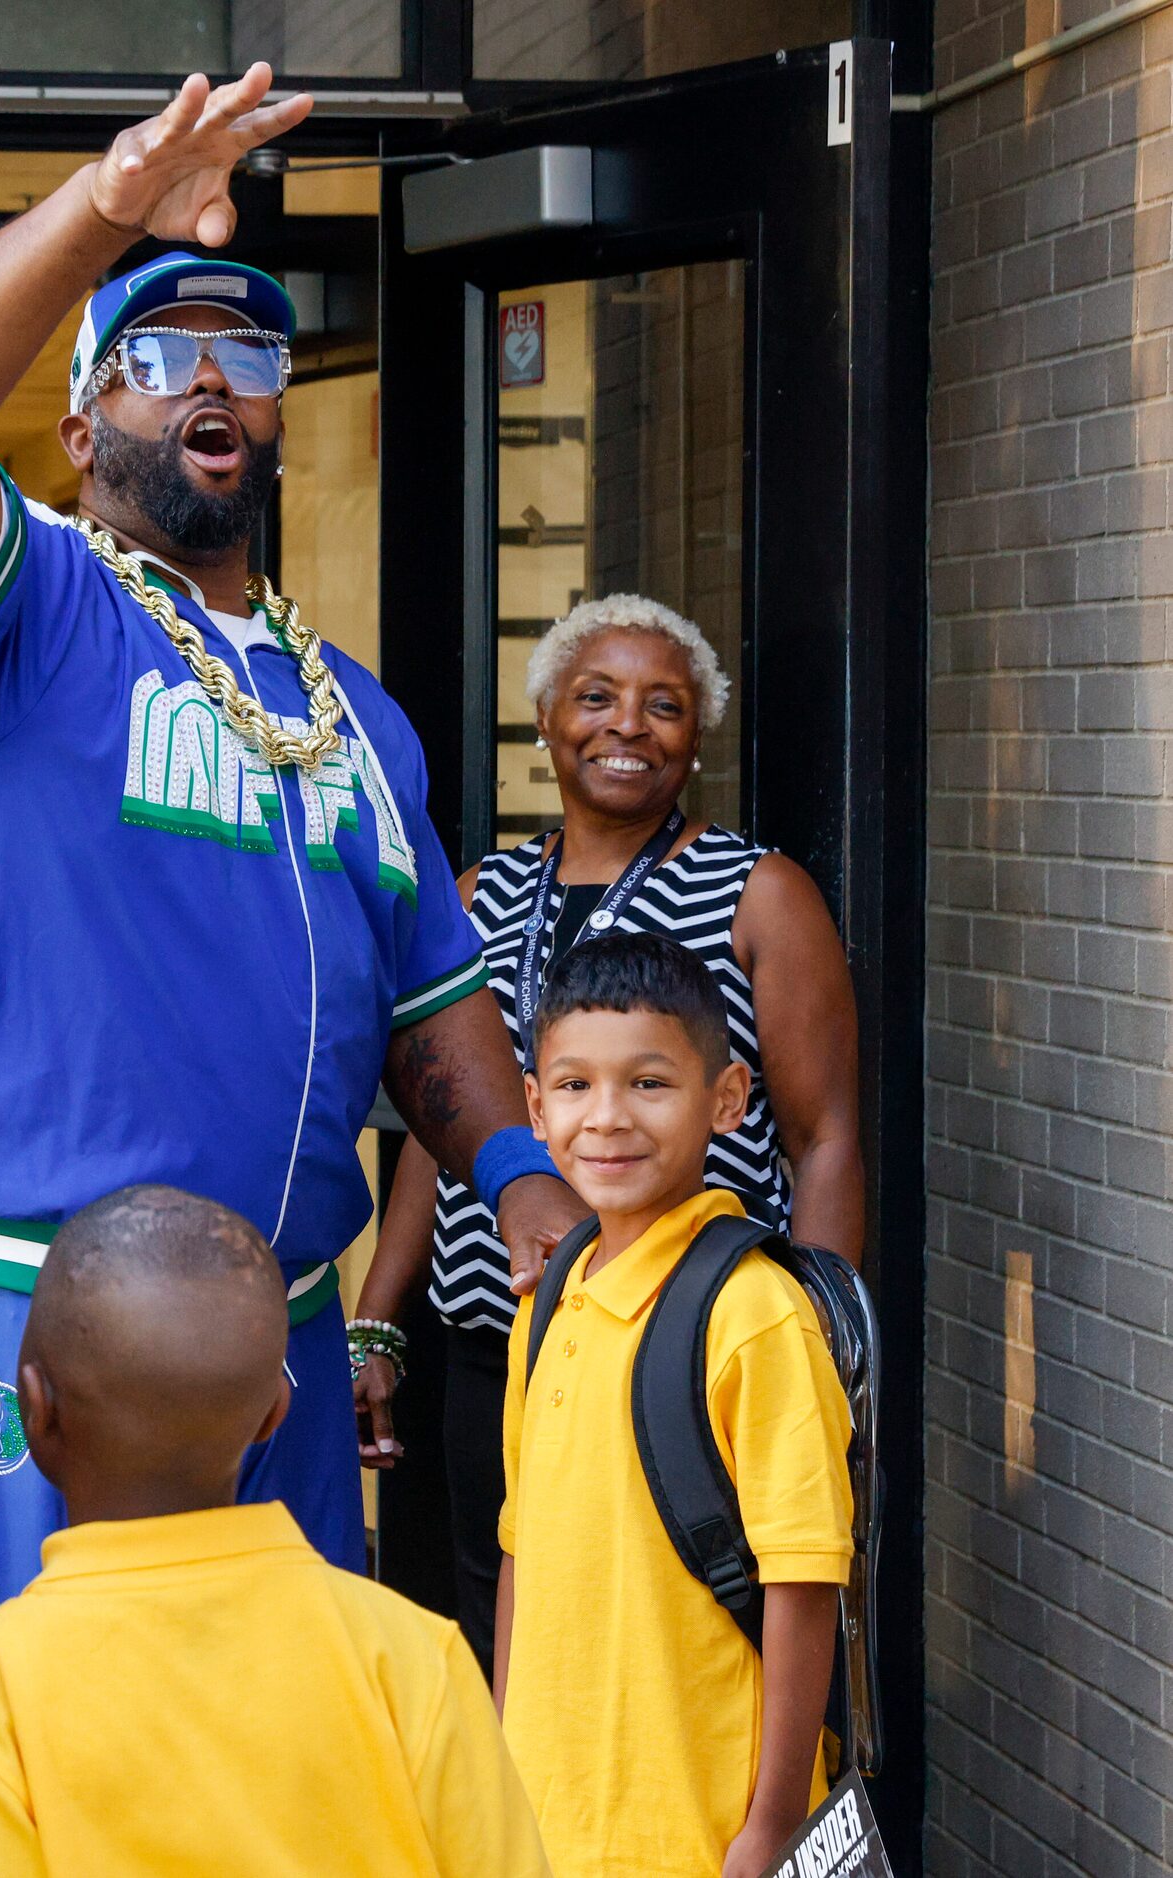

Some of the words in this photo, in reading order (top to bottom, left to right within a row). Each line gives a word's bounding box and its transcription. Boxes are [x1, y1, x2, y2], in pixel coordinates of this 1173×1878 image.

[835, 59, 846, 124] 1
[505, 304, 539, 331] AED
[539, 855, 556, 885] ADELLE
[622, 855, 654, 890] SCHOOL
[533, 886, 547, 915] TURNE
[521, 932, 538, 979] EMENTARY
[521, 980, 533, 1025] SCHOOL
[794, 1788, 864, 1878] INSIDER
